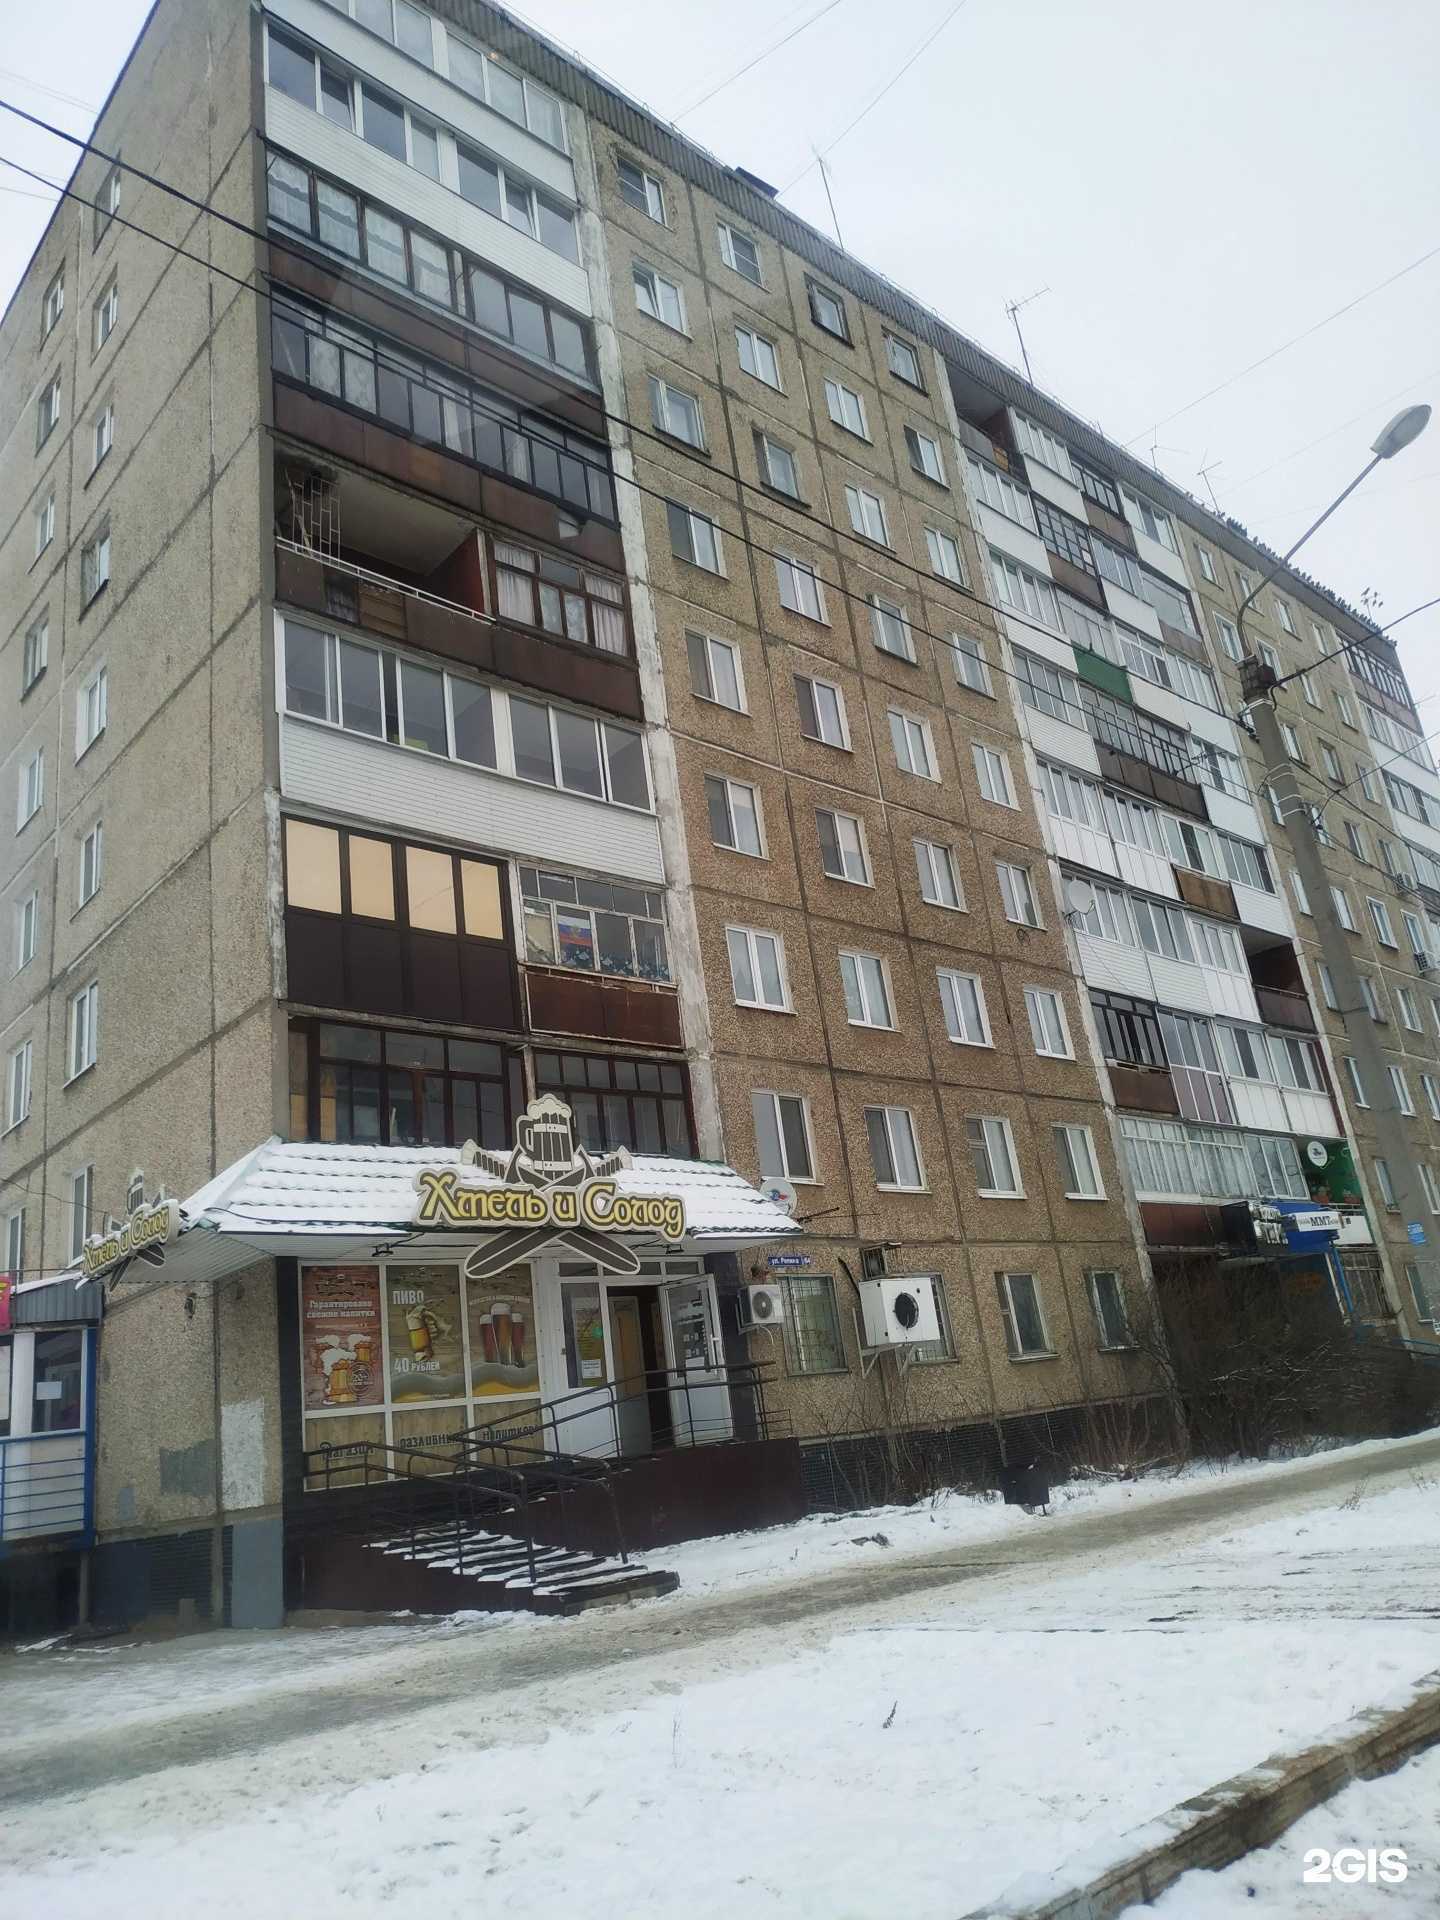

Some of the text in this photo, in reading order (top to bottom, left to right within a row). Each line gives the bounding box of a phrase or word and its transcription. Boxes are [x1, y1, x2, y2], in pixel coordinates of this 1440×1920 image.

[418, 1173, 684, 1238] Хмель и Солод
[392, 1290, 425, 1305] ПИВО
[394, 1357, 410, 1374] 40
[482, 1423, 541, 1441] нпитков
